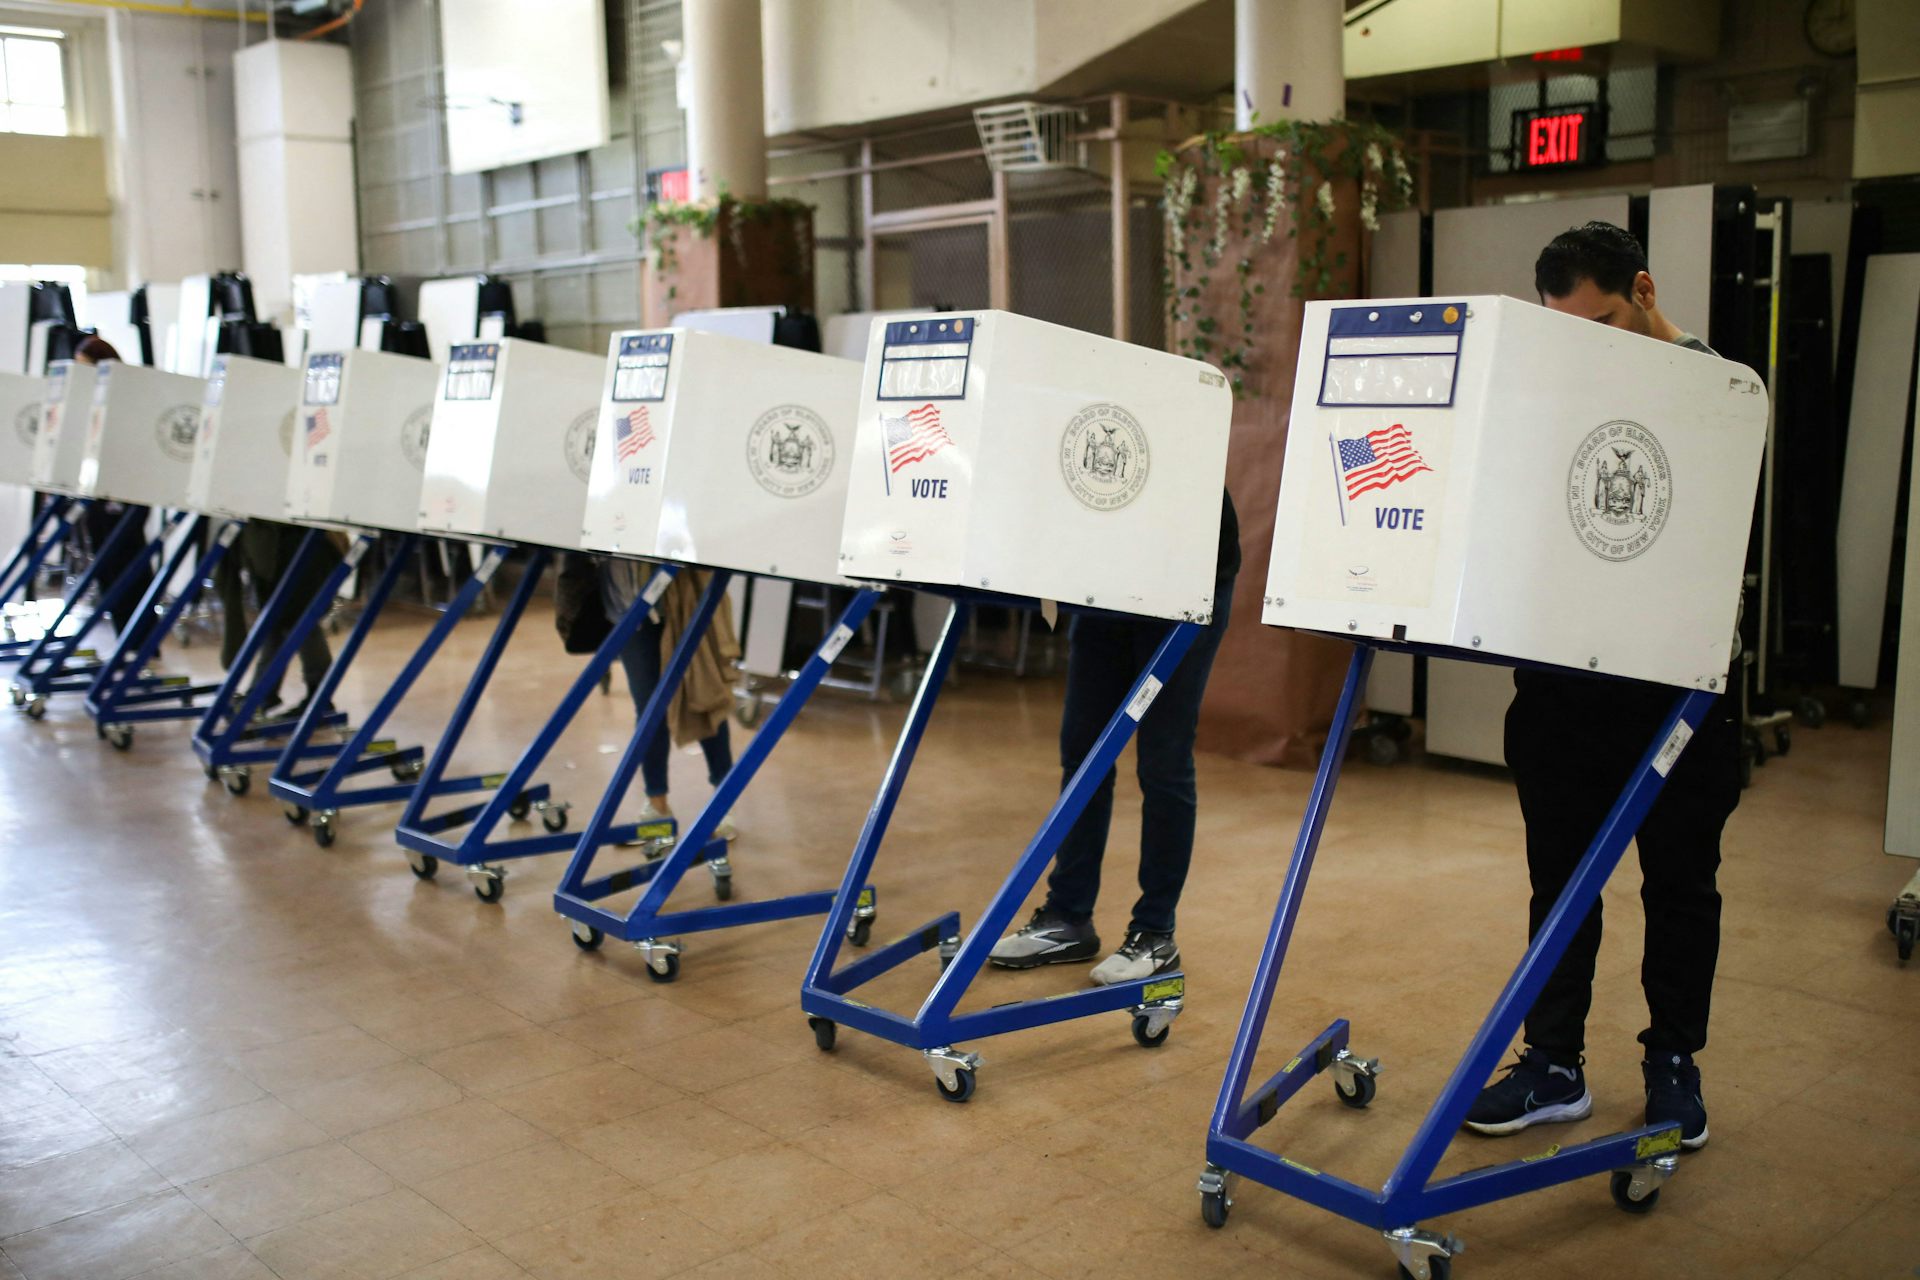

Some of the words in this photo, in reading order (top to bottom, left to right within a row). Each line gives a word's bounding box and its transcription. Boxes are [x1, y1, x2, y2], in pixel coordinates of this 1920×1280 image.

[1529, 113, 1583, 165] EXIT
[1576, 431, 1607, 469] BOARD
[1609, 426, 1623, 438] OF
[1625, 427, 1666, 480] ELECTIONS
[628, 468, 651, 485] VOTE
[911, 478, 948, 499] VOTE
[1375, 507, 1425, 531] VOTE
[1574, 503, 1588, 530] THE
[1586, 530, 1610, 552] CITY
[1610, 544, 1625, 555] OF
[1626, 531, 1649, 553] NEW
[1649, 497, 1667, 532] YORK
